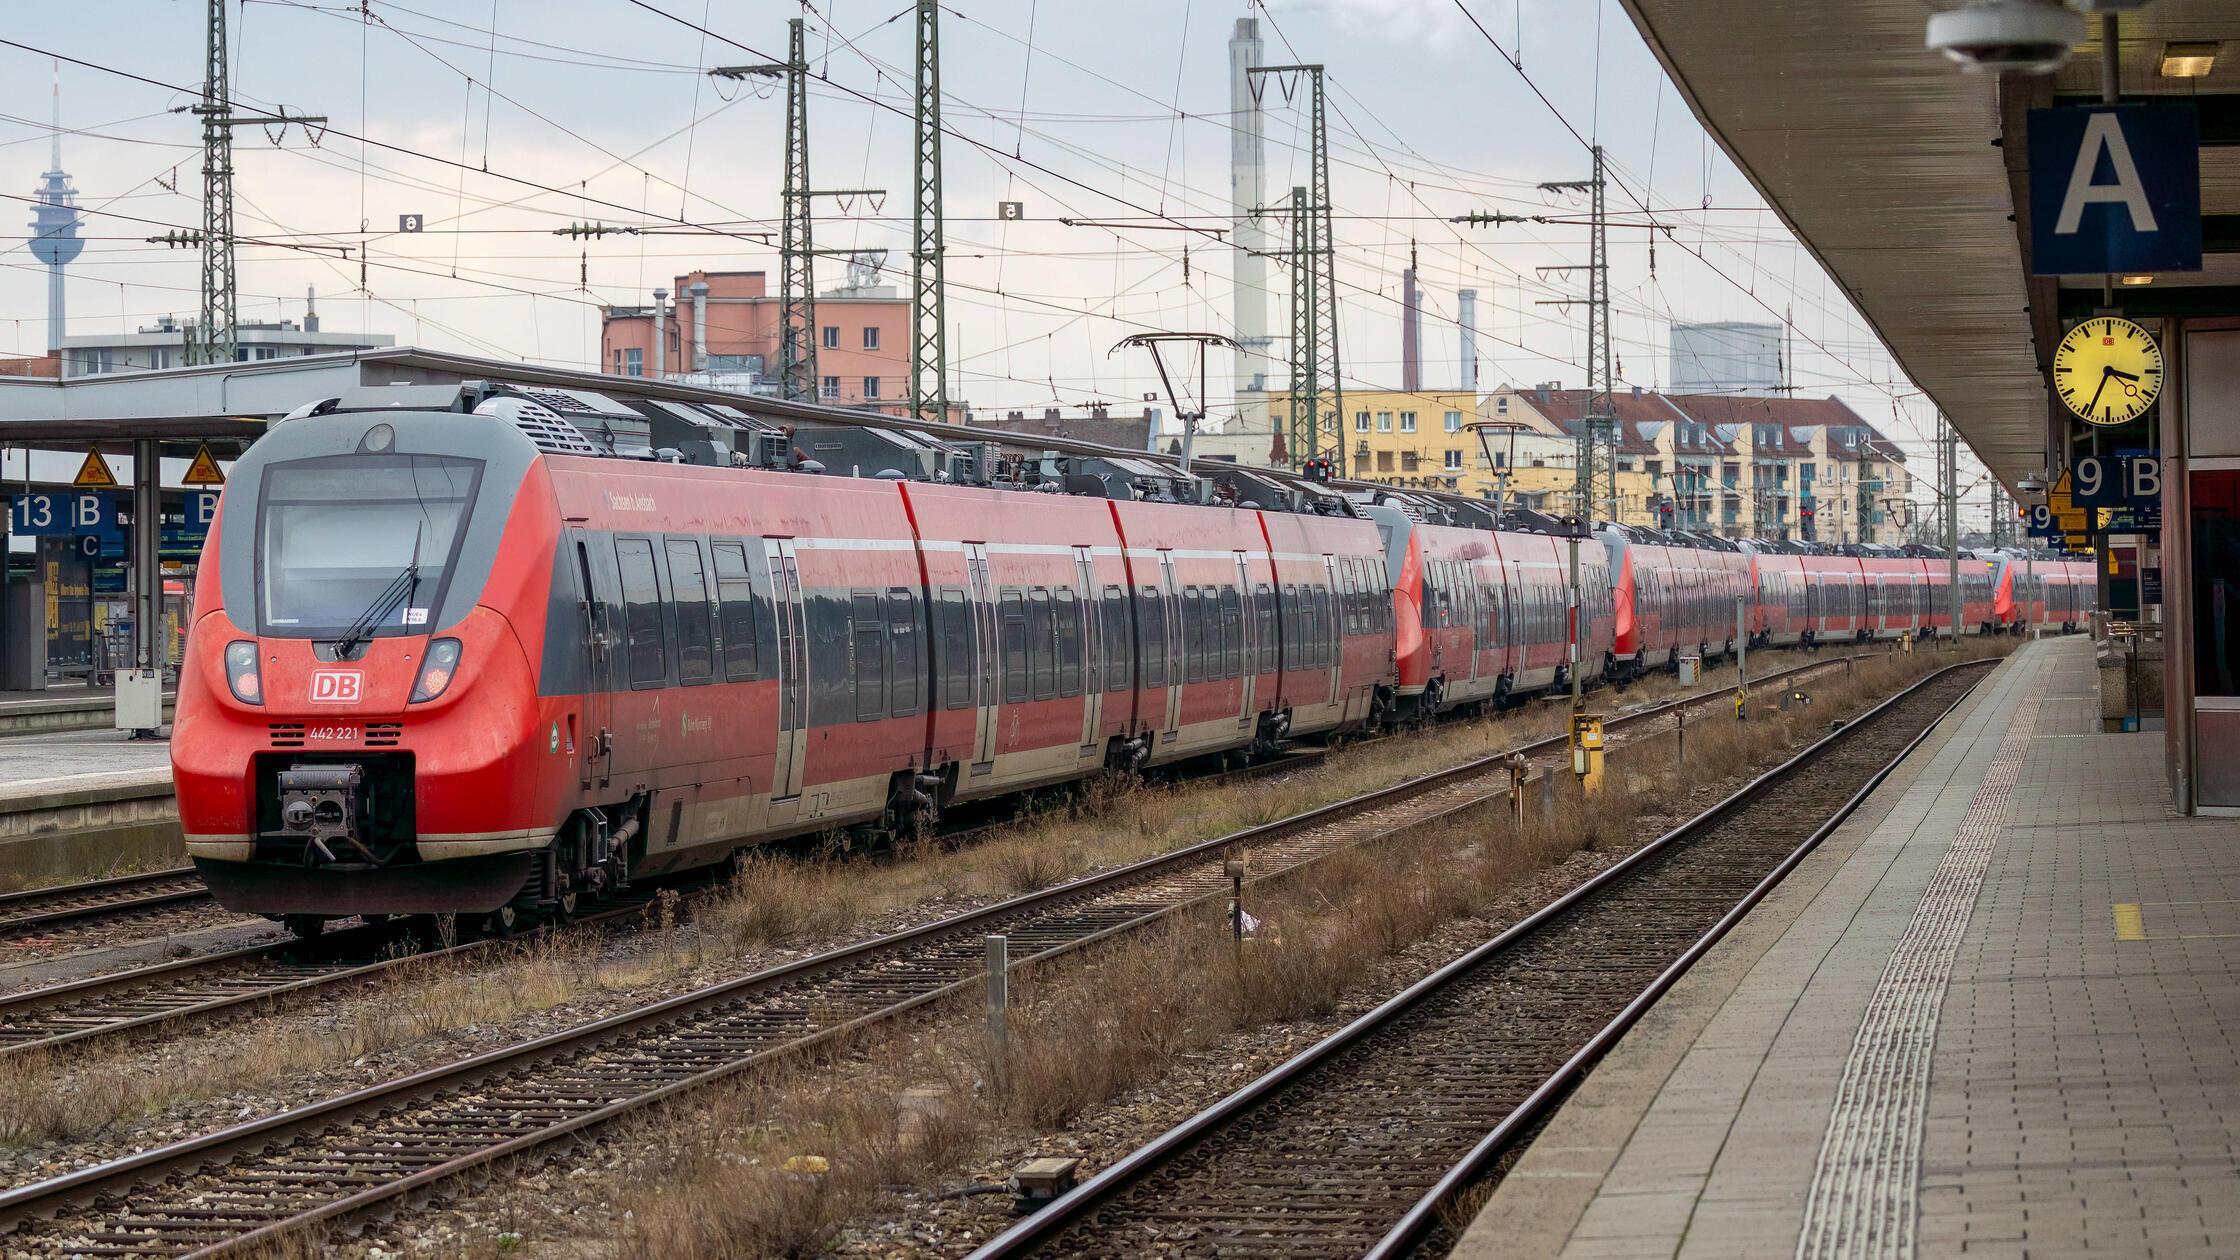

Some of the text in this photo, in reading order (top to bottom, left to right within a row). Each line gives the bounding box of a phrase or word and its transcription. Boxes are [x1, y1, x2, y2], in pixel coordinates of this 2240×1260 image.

[2054, 112, 2160, 234] A
[2077, 458, 2161, 496] 9 B
[17, 495, 101, 527] 13 B
[199, 493, 218, 523] B
[2035, 505, 2051, 529] 9
[83, 536, 98, 556] C
[316, 675, 357, 698] DB
[310, 727, 359, 740] 442 221
